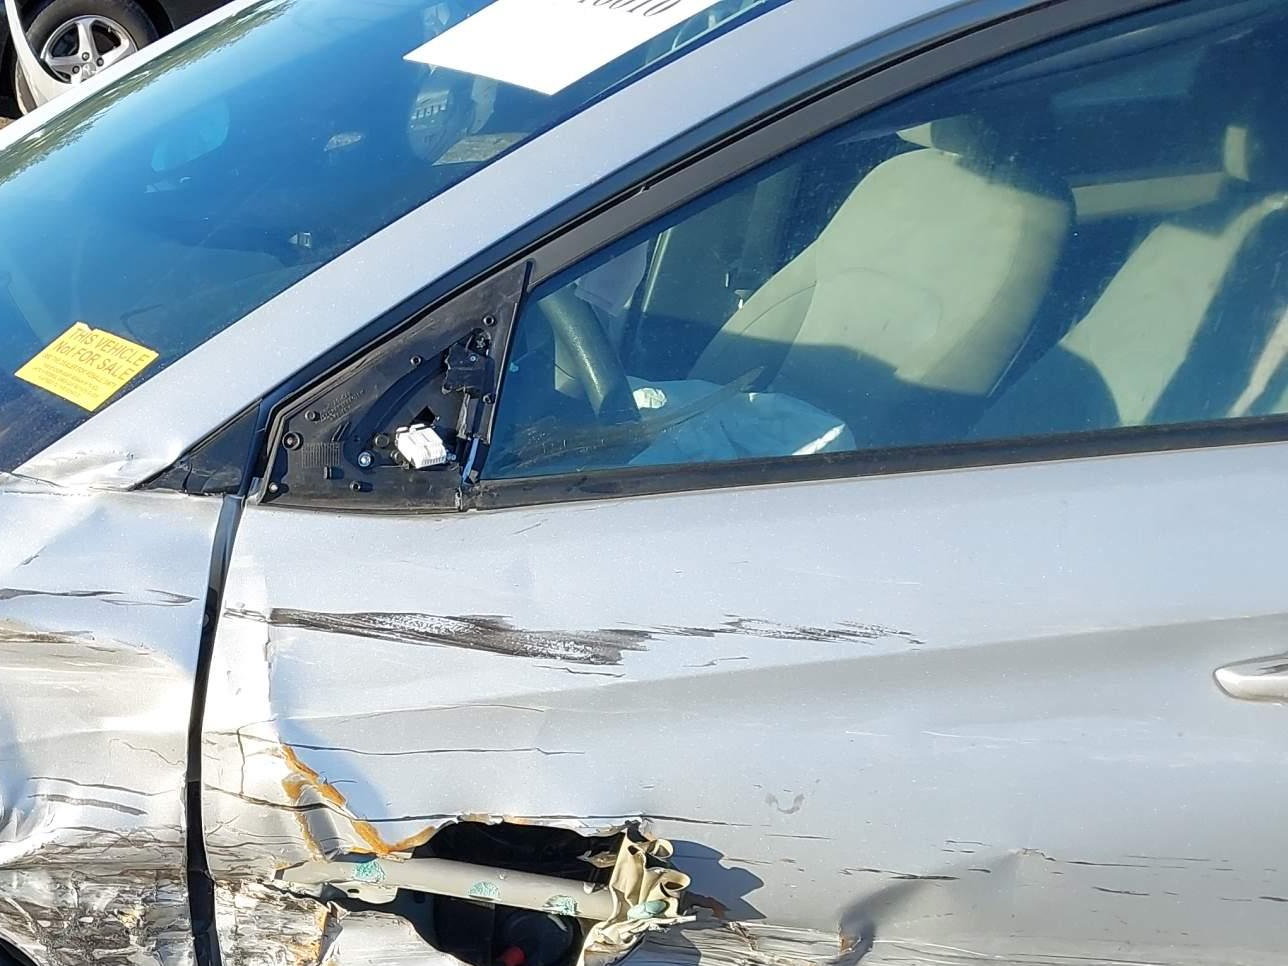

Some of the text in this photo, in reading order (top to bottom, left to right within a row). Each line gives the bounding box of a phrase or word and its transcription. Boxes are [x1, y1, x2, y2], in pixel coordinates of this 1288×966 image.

[68, 327, 150, 367] THIS VEHICLE
[73, 347, 101, 366] FOR
[97, 358, 135, 381] SALE
